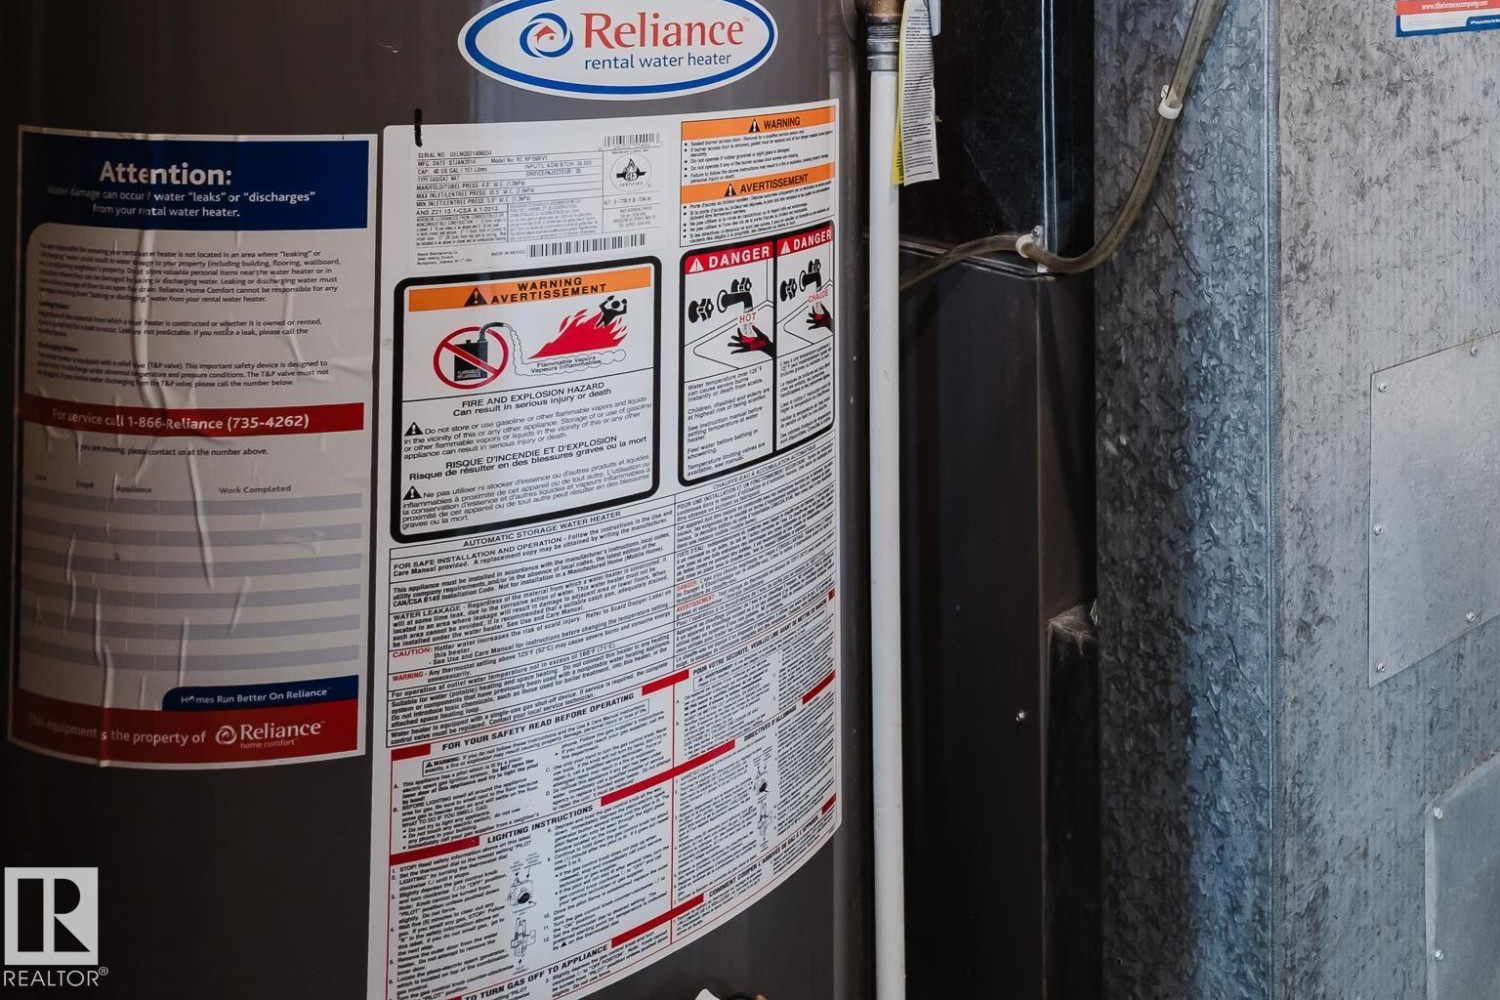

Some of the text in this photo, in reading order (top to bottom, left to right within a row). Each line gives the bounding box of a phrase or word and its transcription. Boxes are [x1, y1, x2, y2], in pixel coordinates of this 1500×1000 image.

[581, 11, 744, 49] Reliance
[585, 52, 731, 70] rental water heater
[763, 116, 801, 130] WARNING
[99, 161, 232, 186] Attention:
[740, 173, 809, 194] AVERTISSEMENT
[103, 191, 118, 199] can
[120, 192, 145, 200] occur
[153, 192, 185, 201] water
[188, 192, 226, 202] "leaks"
[228, 194, 240, 202] or
[243, 191, 316, 204] "discharges"
[116, 206, 136, 217] your
[168, 207, 200, 217] water
[202, 207, 241, 217] heater.
[793, 231, 832, 251] DANGER
[708, 246, 770, 268] DANGER
[517, 277, 583, 292] WARNING
[491, 284, 607, 305] AVERTISSEMENT
[808, 288, 829, 303] CHAUDE
[739, 312, 757, 323] HOT
[453, 409, 472, 417] Can
[474, 405, 501, 414] result
[504, 403, 512, 411] in
[515, 399, 548, 409] serious
[551, 395, 575, 405] injury
[589, 388, 612, 398] death
[461, 382, 605, 408] FIRE AND EXPLOSION HAZARD
[68, 412, 102, 425] service
[105, 414, 124, 427] call
[127, 416, 223, 430] 1-866-Reliance
[227, 413, 310, 431] (735-4262)
[451, 424, 469, 432] store
[481, 421, 494, 429] use
[496, 417, 526, 428] gasoline
[409, 471, 443, 480] Risque
[460, 464, 495, 475] résulter
[512, 459, 528, 467] des
[531, 451, 574, 464] blessures
[576, 446, 604, 457] graves
[628, 436, 647, 446] mort
[446, 435, 618, 470] RISQUE D'INCENDIE ET D'EXPLOSION
[218, 485, 291, 495] Work Completed
[462, 511, 621, 548] AUTOMATIC STORAGE WATER HEATER
[393, 537, 562, 570] FOR SAFE INSTALLATION AND OPERATION
[393, 611, 421, 620] WATER
[217, 695, 235, 704] Run
[237, 694, 267, 703] Better
[269, 692, 284, 700] On
[286, 689, 327, 699] Reliance
[441, 692, 635, 751] FOR YOUR SAFETY READ BEFORE OPERATING
[111, 729, 130, 742] the
[133, 732, 189, 746] property
[192, 731, 207, 743] of
[240, 722, 322, 741] Reliance
[240, 738, 295, 749] home comfort
[486, 805, 594, 844] LIGHTING INSTRUCTIONS
[480, 985, 507, 999] TURN
[507, 978, 525, 990] GAS
[527, 971, 546, 983] OFF
[547, 965, 560, 974] TO
[561, 943, 608, 970] APPLIANCE
